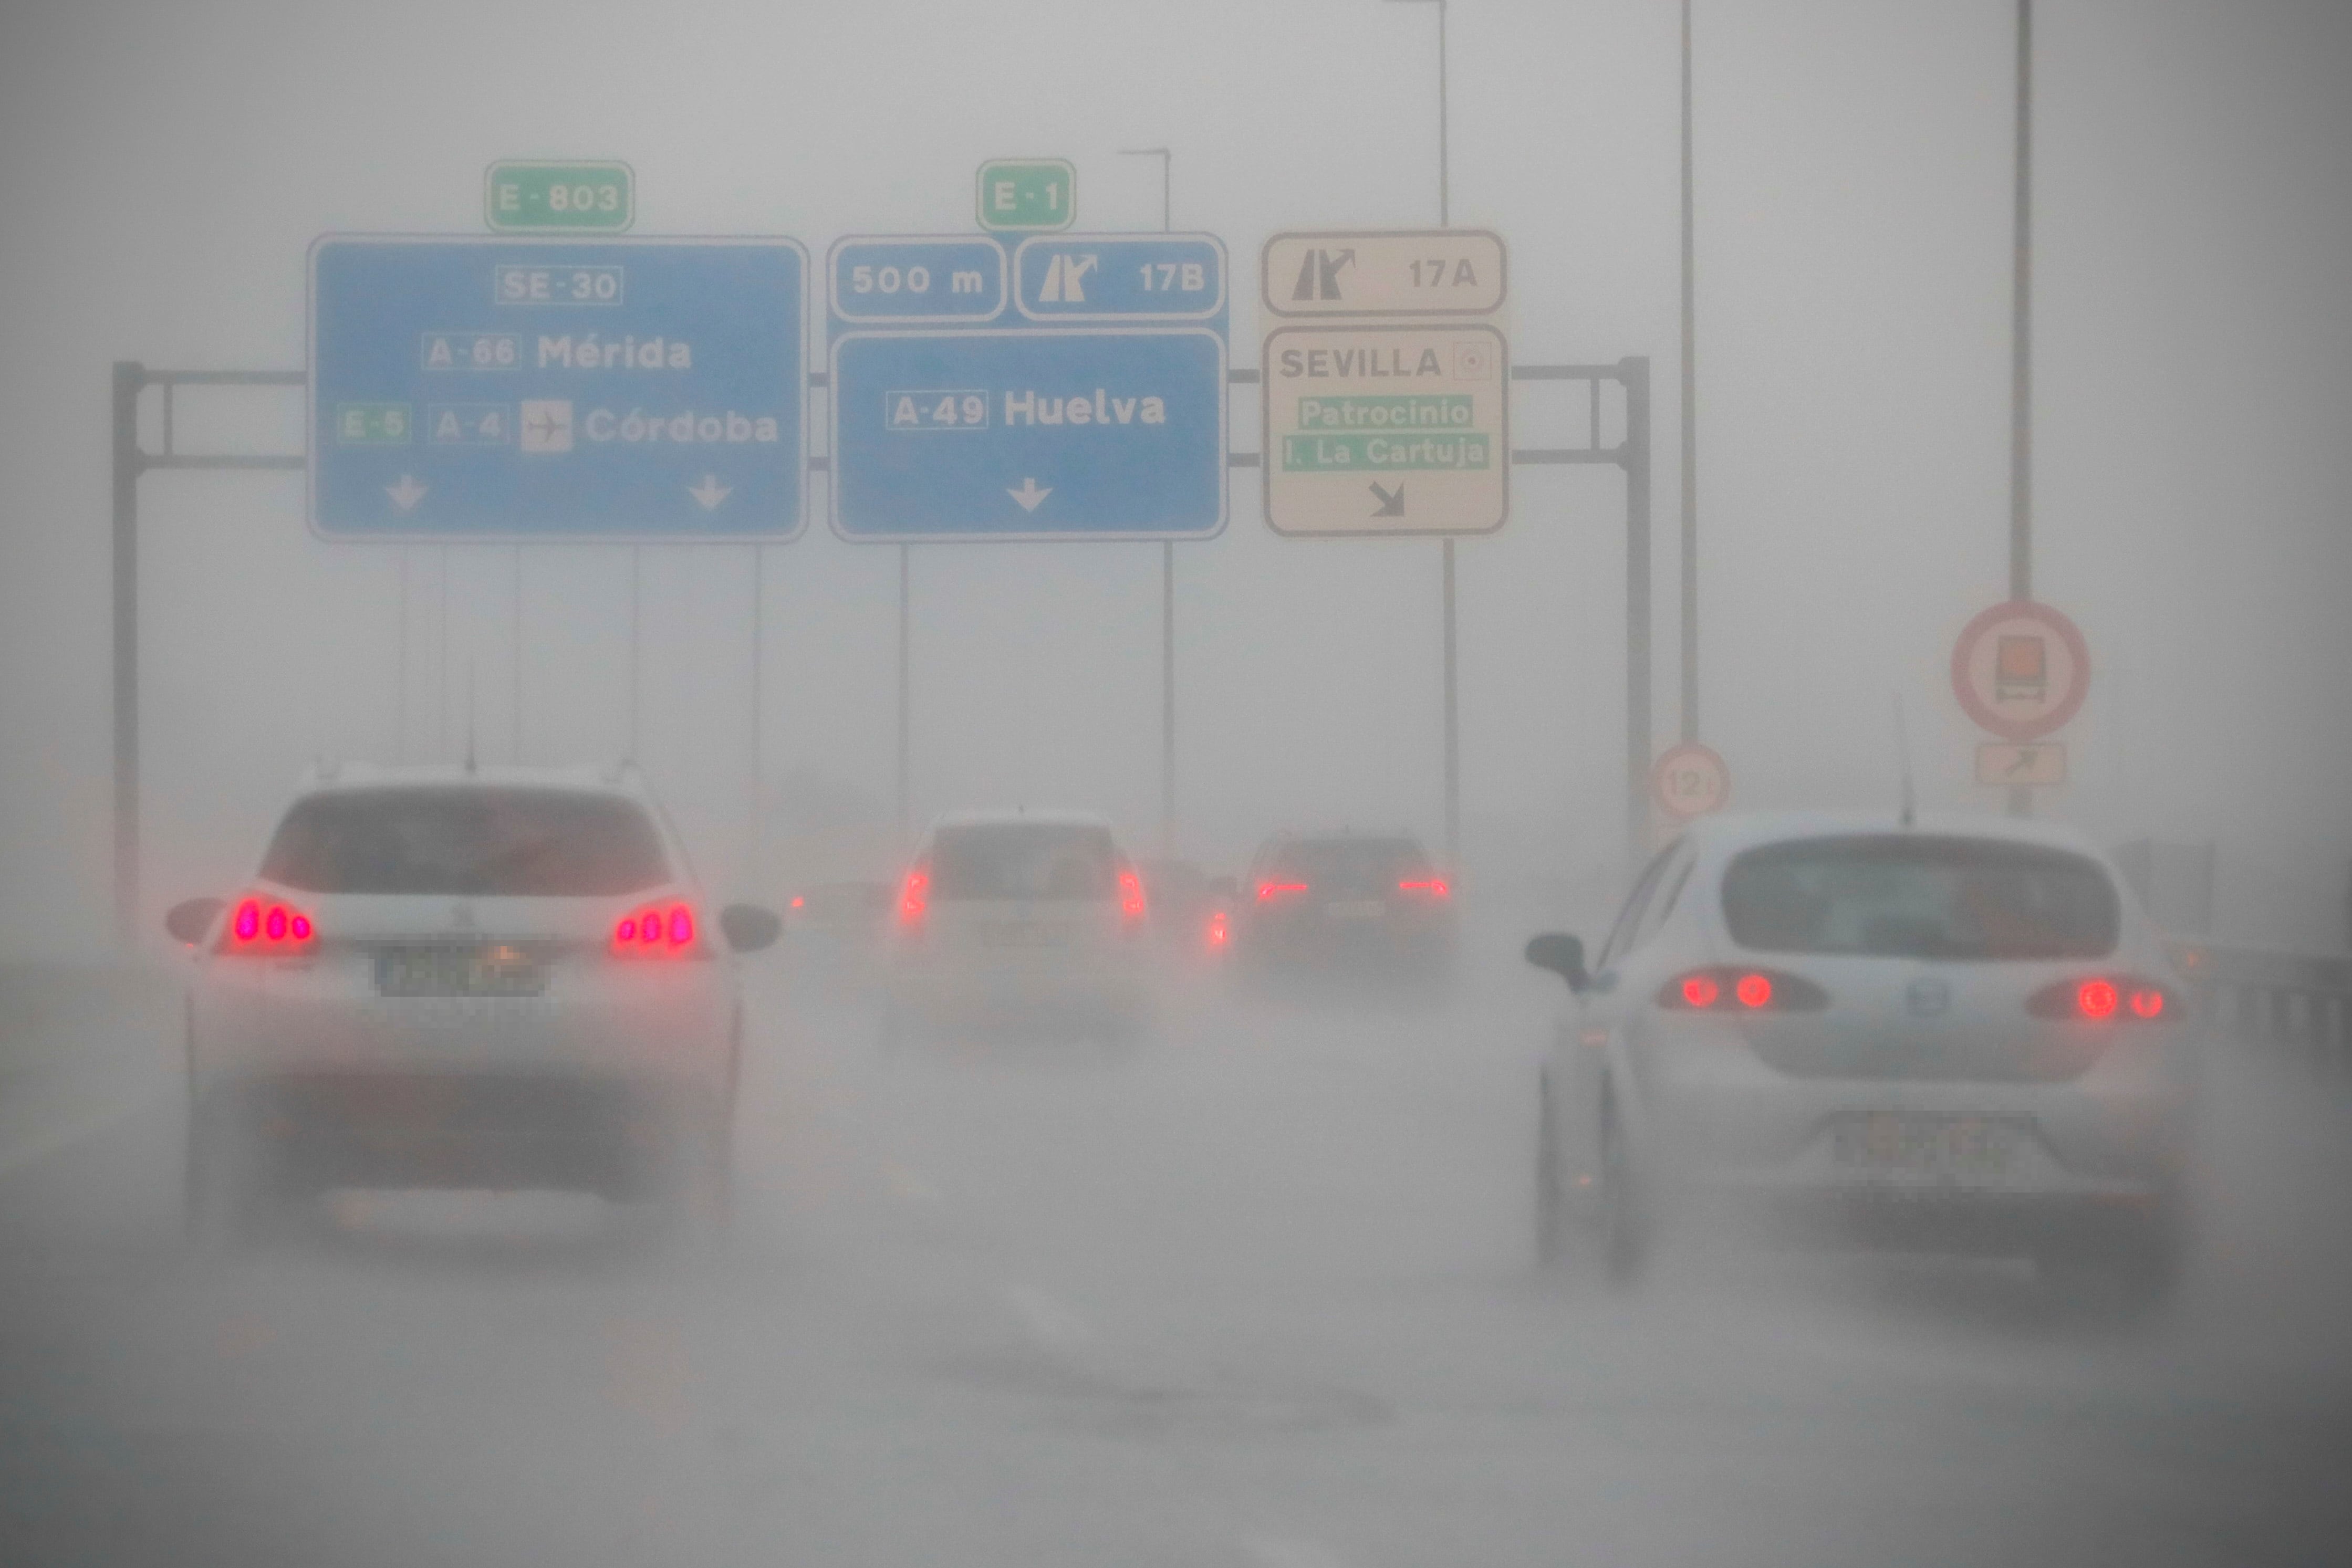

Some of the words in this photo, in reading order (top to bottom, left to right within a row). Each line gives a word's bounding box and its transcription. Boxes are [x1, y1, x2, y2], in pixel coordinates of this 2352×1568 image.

[499, 185, 618, 210] E-803
[994, 182, 1058, 210] E-1
[503, 271, 617, 299] SE-30
[852, 267, 930, 293] 500
[952, 270, 982, 293] m
[1140, 263, 1204, 291] 17B
[1409, 258, 1477, 287] 17A
[428, 338, 515, 365] A-66
[538, 332, 692, 369] Mérida
[1279, 348, 1442, 378] SEVILLA
[893, 396, 984, 425] A-49
[1005, 389, 1165, 425] Huelva
[1302, 399, 1469, 427] Patrocinio
[344, 410, 404, 437] E-5
[436, 411, 500, 437] A-4
[586, 406, 778, 443] Córdoba
[1317, 440, 1350, 465] La
[1367, 437, 1484, 468] Cartuja
